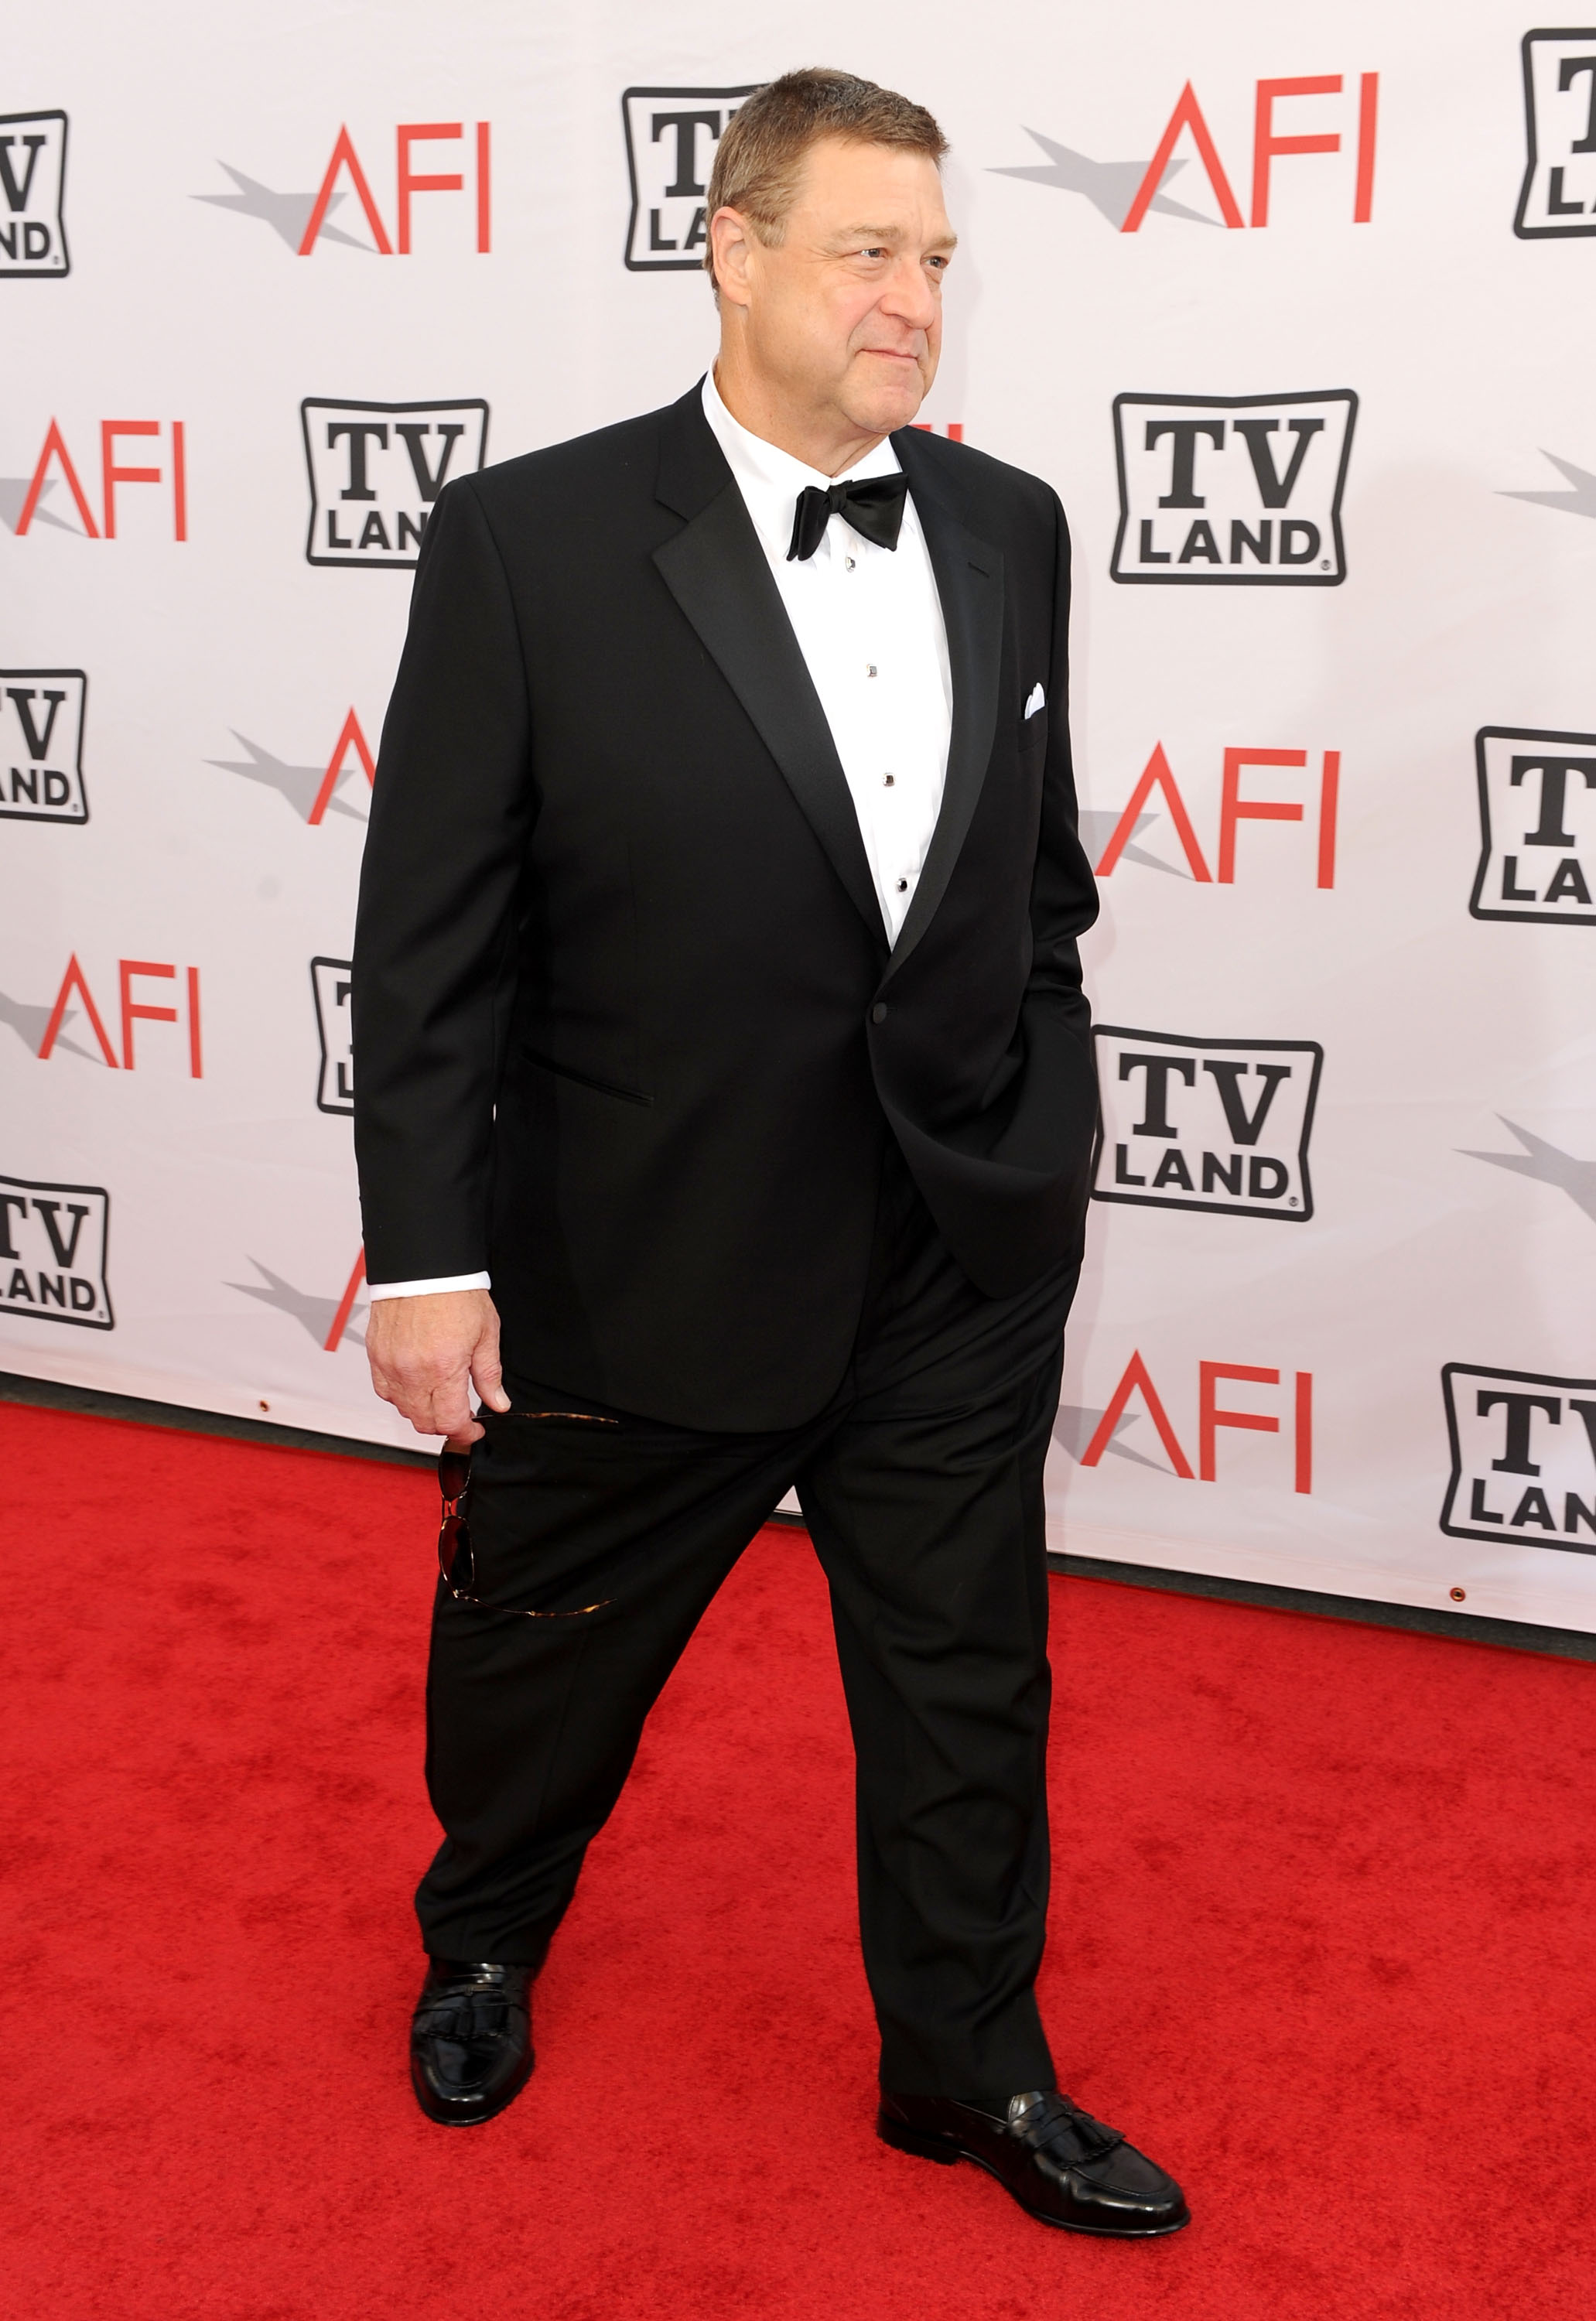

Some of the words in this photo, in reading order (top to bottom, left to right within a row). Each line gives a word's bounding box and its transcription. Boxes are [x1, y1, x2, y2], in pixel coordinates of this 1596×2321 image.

[0, 135, 46, 211] V
[299, 121, 490, 255] AFI
[652, 111, 720, 197] T
[1121, 72, 1379, 232] AFI
[0, 222, 50, 260] ND
[15, 418, 186, 542] AFI
[327, 422, 464, 501] TV
[1145, 419, 1324, 509] TV
[327, 509, 427, 550] LAN
[0, 688, 66, 761] V
[0, 767, 70, 806] ND
[1094, 741, 1341, 890] AFI
[1510, 755, 1596, 848] T
[1501, 855, 1594, 904] LA
[38, 952, 203, 1079] AFI
[1119, 1053, 1292, 1146] TV
[0, 1267, 97, 1312] AND
[1080, 1349, 1313, 1495] AFI
[1469, 1478, 1596, 1534] LAN
